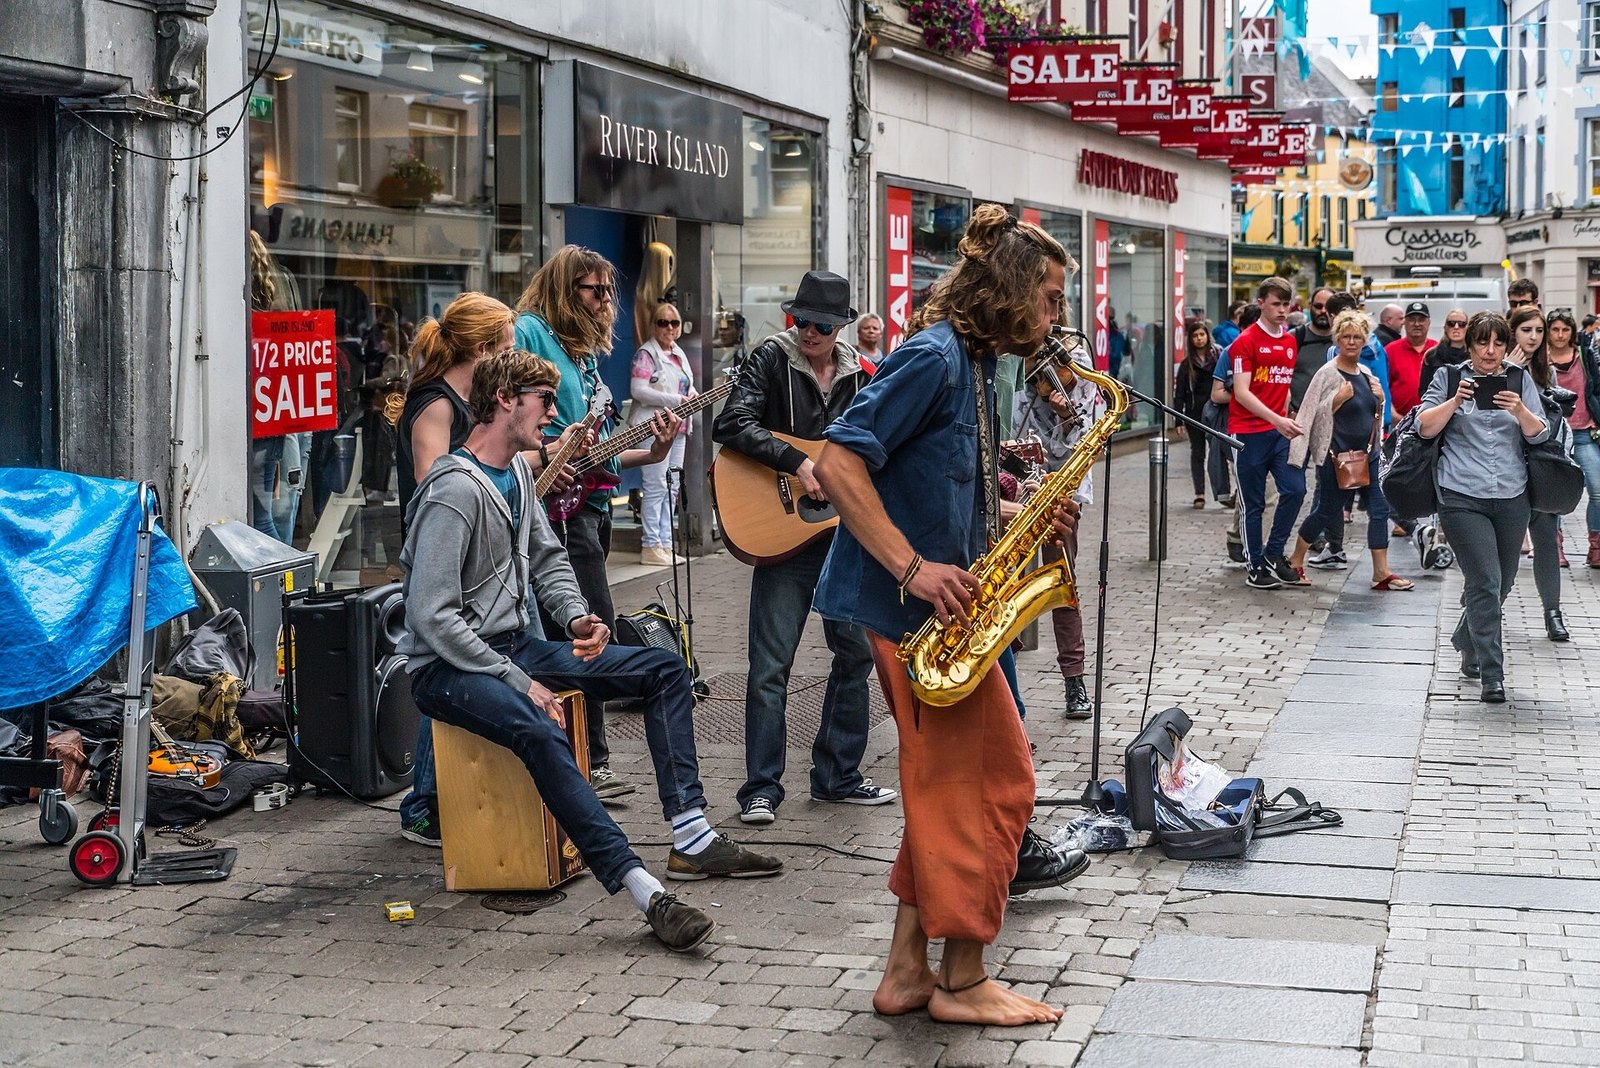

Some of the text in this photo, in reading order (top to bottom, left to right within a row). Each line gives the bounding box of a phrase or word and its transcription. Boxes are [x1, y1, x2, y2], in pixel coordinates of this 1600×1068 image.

[1010, 54, 1118, 84] SALE
[1173, 95, 1210, 119] LE
[1211, 109, 1247, 133] LE
[600, 114, 729, 178] RIVER ISLAND
[1078, 148, 1179, 204] ANTHONY RYANS
[1385, 227, 1482, 251] Claddagh
[1392, 247, 1468, 263] Jewellers
[1095, 240, 1108, 357] SALE
[1174, 249, 1184, 350] SALE
[270, 321, 315, 334] RIVER ISLAND
[253, 340, 332, 373] 1/2 PRICE
[255, 372, 333, 423] SALE
